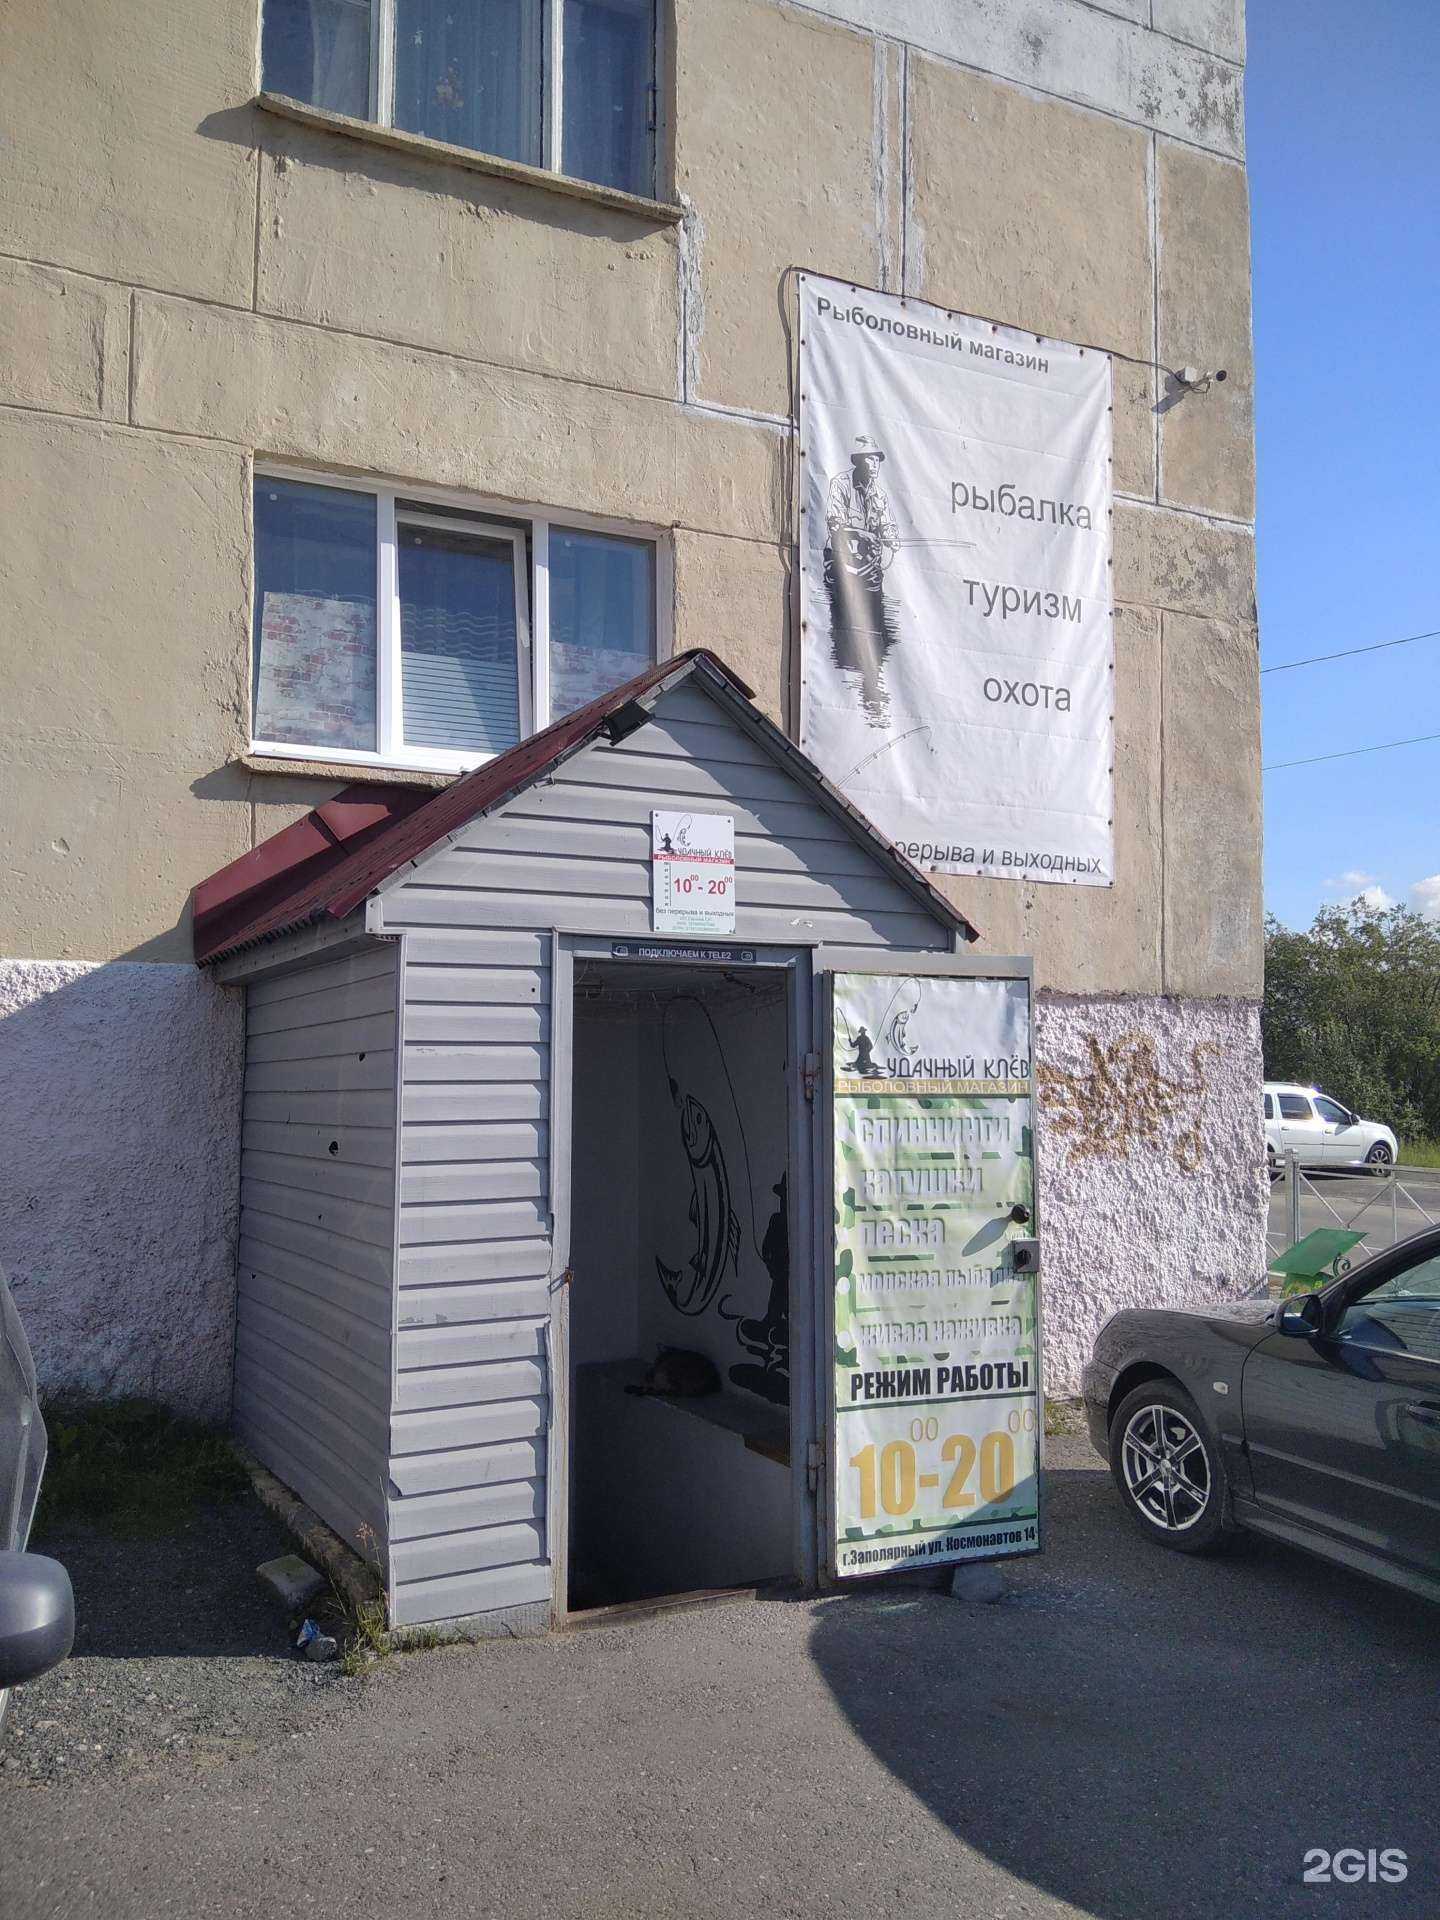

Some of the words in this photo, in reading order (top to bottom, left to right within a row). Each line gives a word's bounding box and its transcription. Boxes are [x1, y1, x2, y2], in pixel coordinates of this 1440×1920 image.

[817, 296, 963, 351] Рыболовный
[969, 340, 1049, 374] магазин
[951, 480, 1092, 530] рыбалка
[963, 578, 1083, 623] туризм
[983, 677, 1072, 712] охота
[982, 849, 995, 864] и
[1001, 850, 1103, 874] выходных
[638, 947, 699, 959] ПОДКЛЮЧАЕМ
[708, 950, 732, 960] TELE2
[887, 1054, 975, 1079] УДАЧНЫЙ
[984, 1054, 1029, 1079] КЛЁВ
[838, 1079, 952, 1093] РЫБОЛОВНЫЙ
[957, 1080, 1028, 1093] МАГАЗИН
[851, 1368, 931, 1401] РЕЖИМ
[937, 1361, 1029, 1394] РАБОТЫ
[945, 1530, 1022, 1552] Космонавтов
[1023, 1526, 1036, 1541] 14
